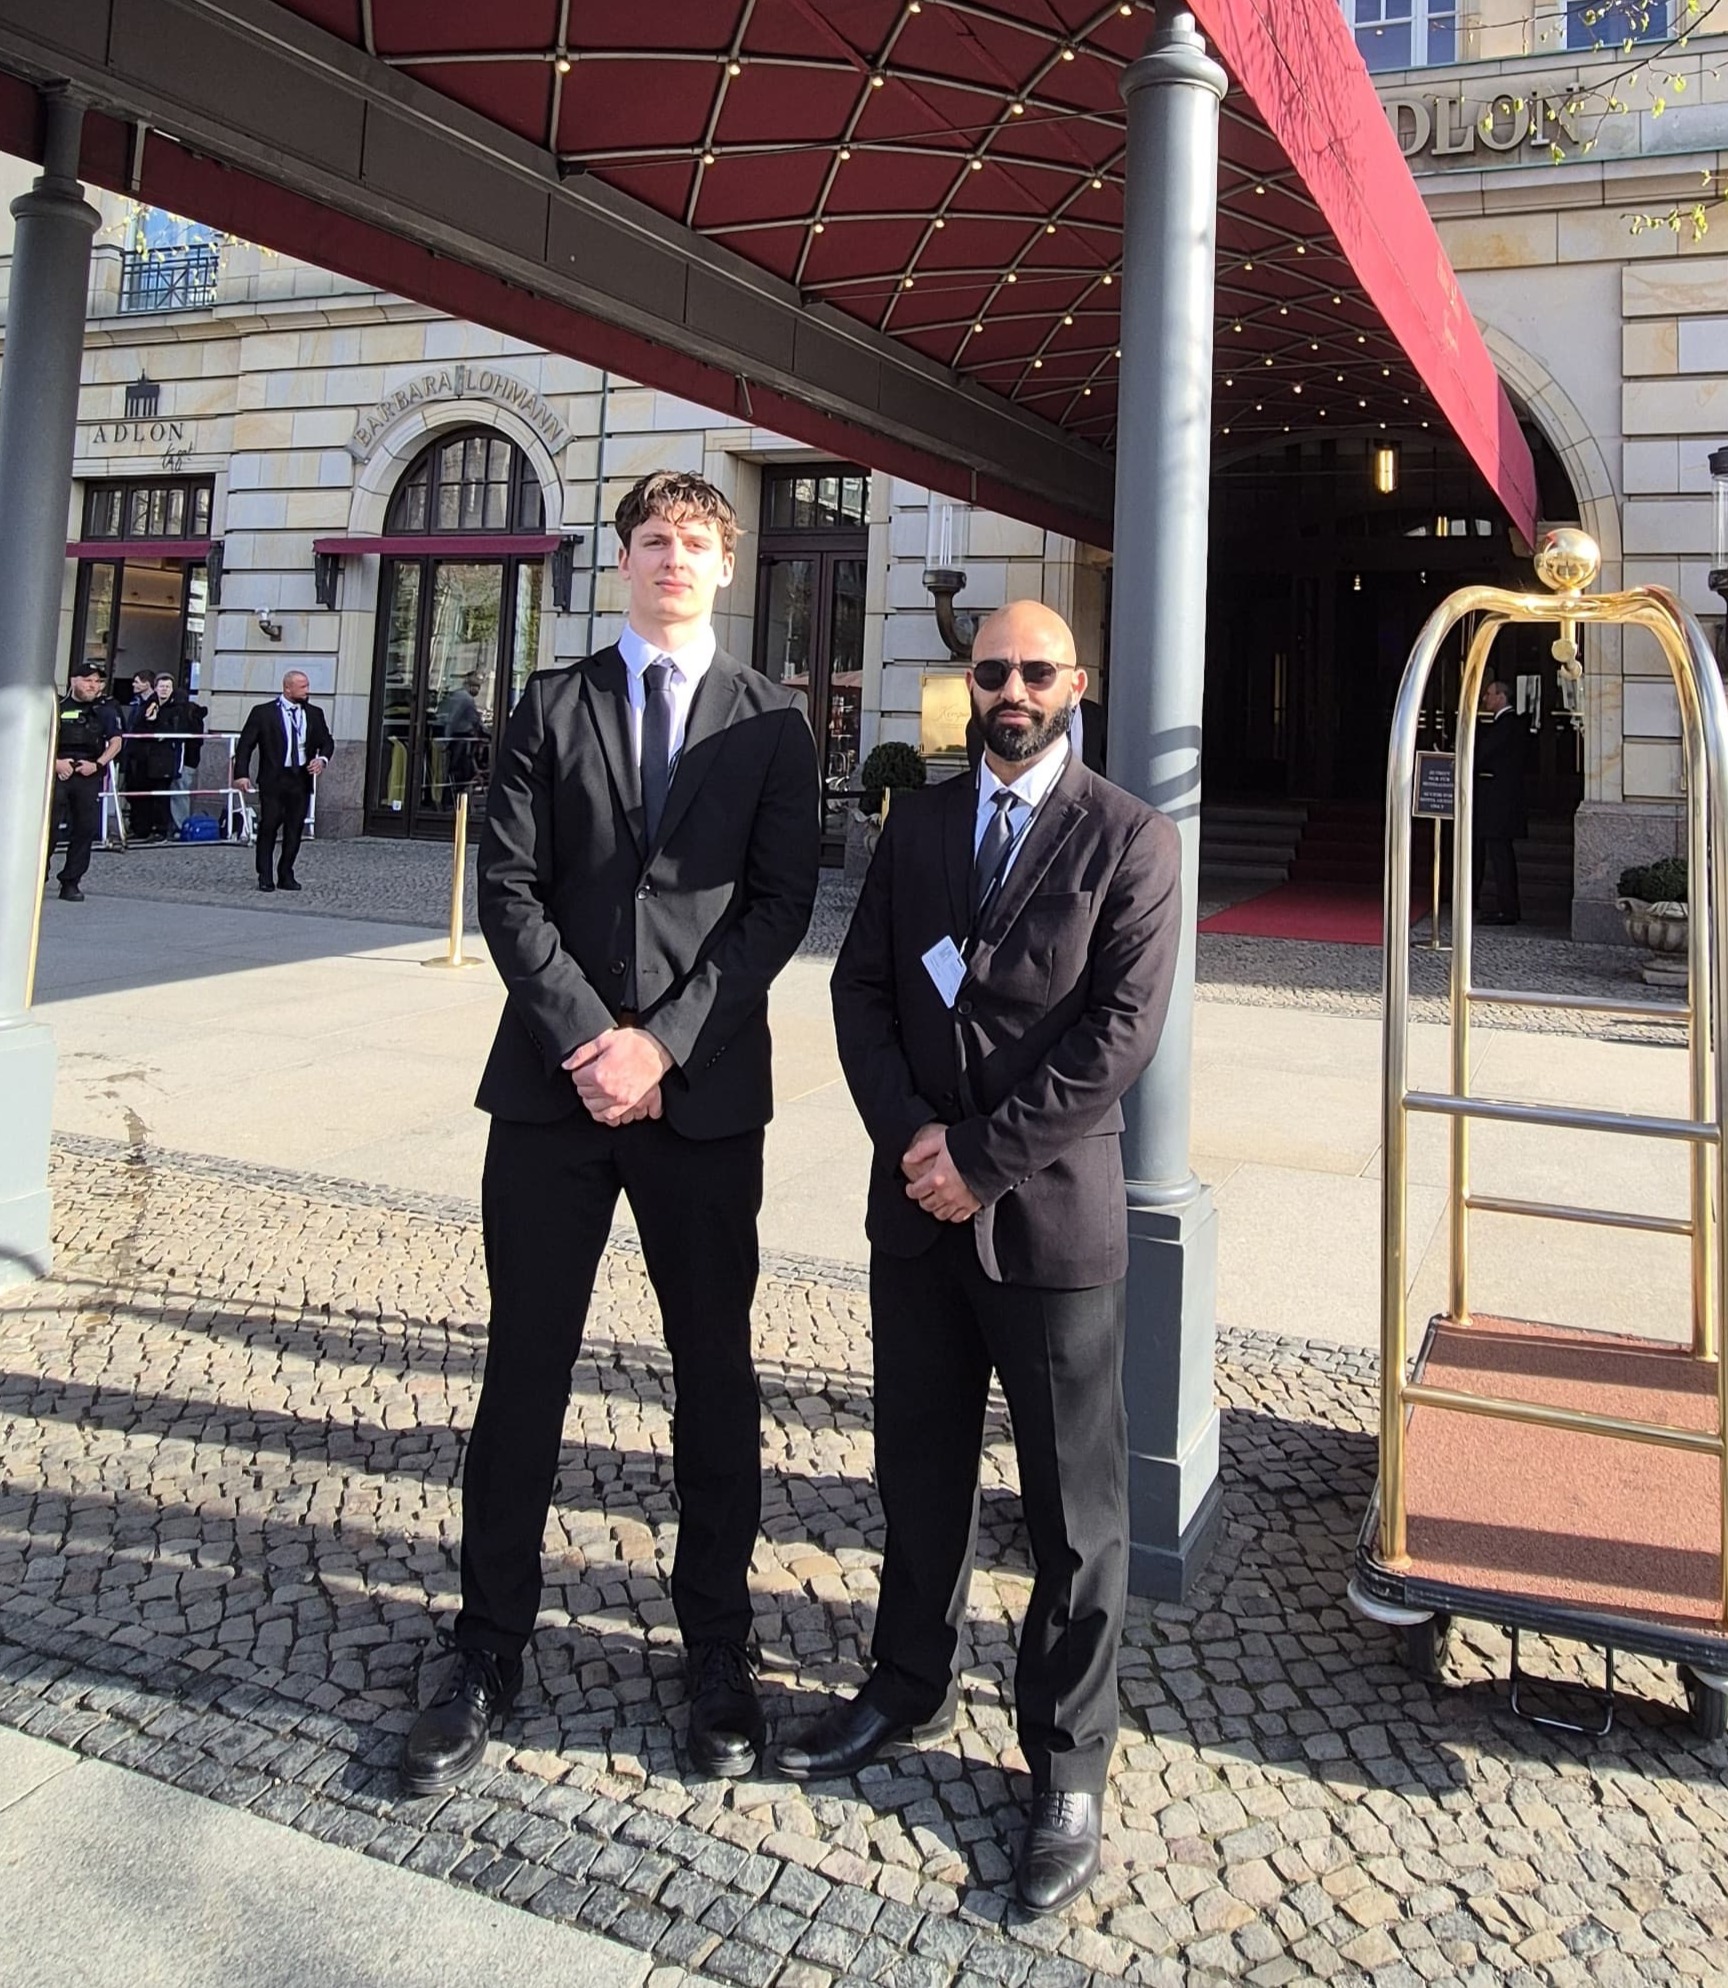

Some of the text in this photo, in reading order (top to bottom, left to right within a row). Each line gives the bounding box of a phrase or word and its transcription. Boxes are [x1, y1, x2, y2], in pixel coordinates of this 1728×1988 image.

[1384, 83, 1583, 157] DLON
[93, 422, 183, 443] ADLON
[354, 369, 564, 446] BARBARA LOHMANN
